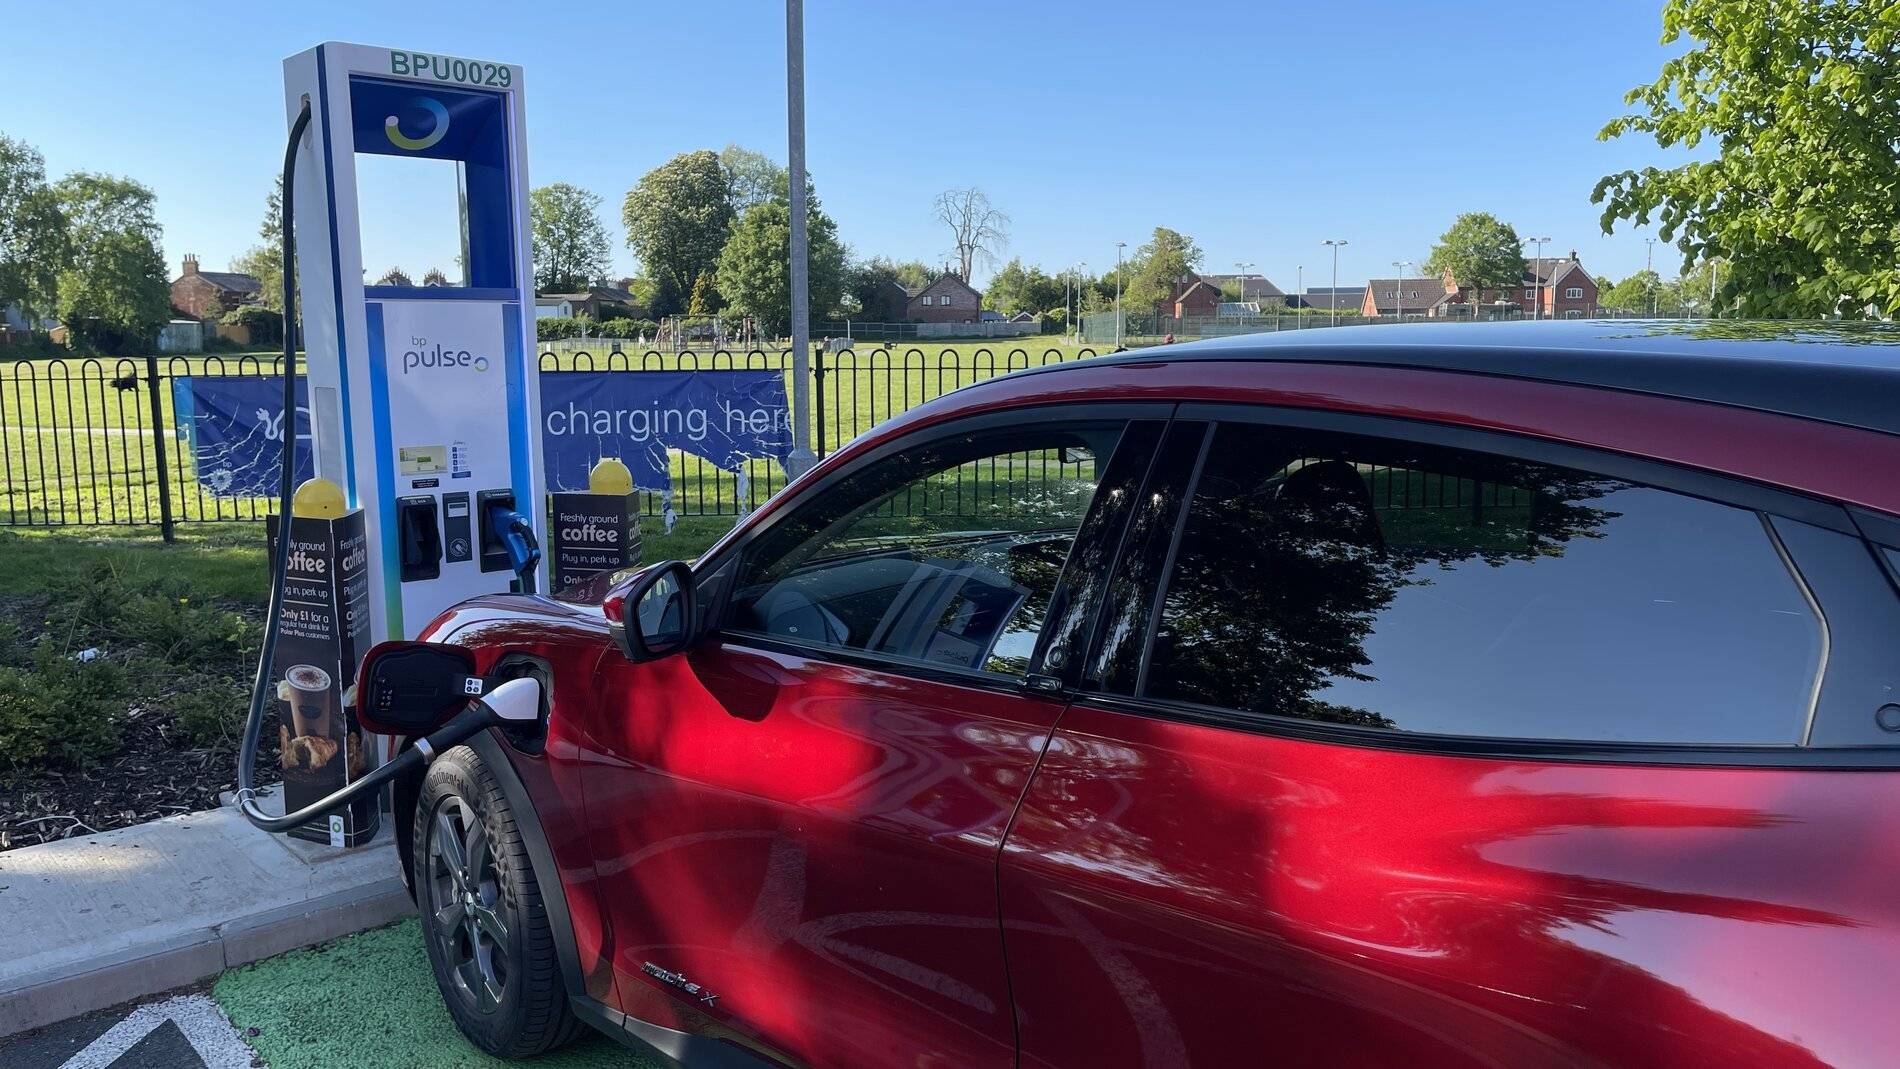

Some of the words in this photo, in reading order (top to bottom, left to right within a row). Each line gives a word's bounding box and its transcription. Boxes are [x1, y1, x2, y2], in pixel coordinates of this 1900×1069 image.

[390, 51, 512, 87] BPU0029
[411, 336, 427, 347] bp
[403, 344, 472, 374] pulse
[547, 401, 708, 442] charging
[560, 513, 587, 524] Freshly
[588, 515, 618, 524] ground
[562, 524, 618, 543] coffee
[298, 541, 325, 552] ground
[287, 551, 326, 573] offee
[342, 548, 366, 571] coffee
[562, 553, 578, 564] Plug
[590, 556, 607, 564] perk
[300, 611, 308, 620] £1
[311, 612, 321, 622] for
